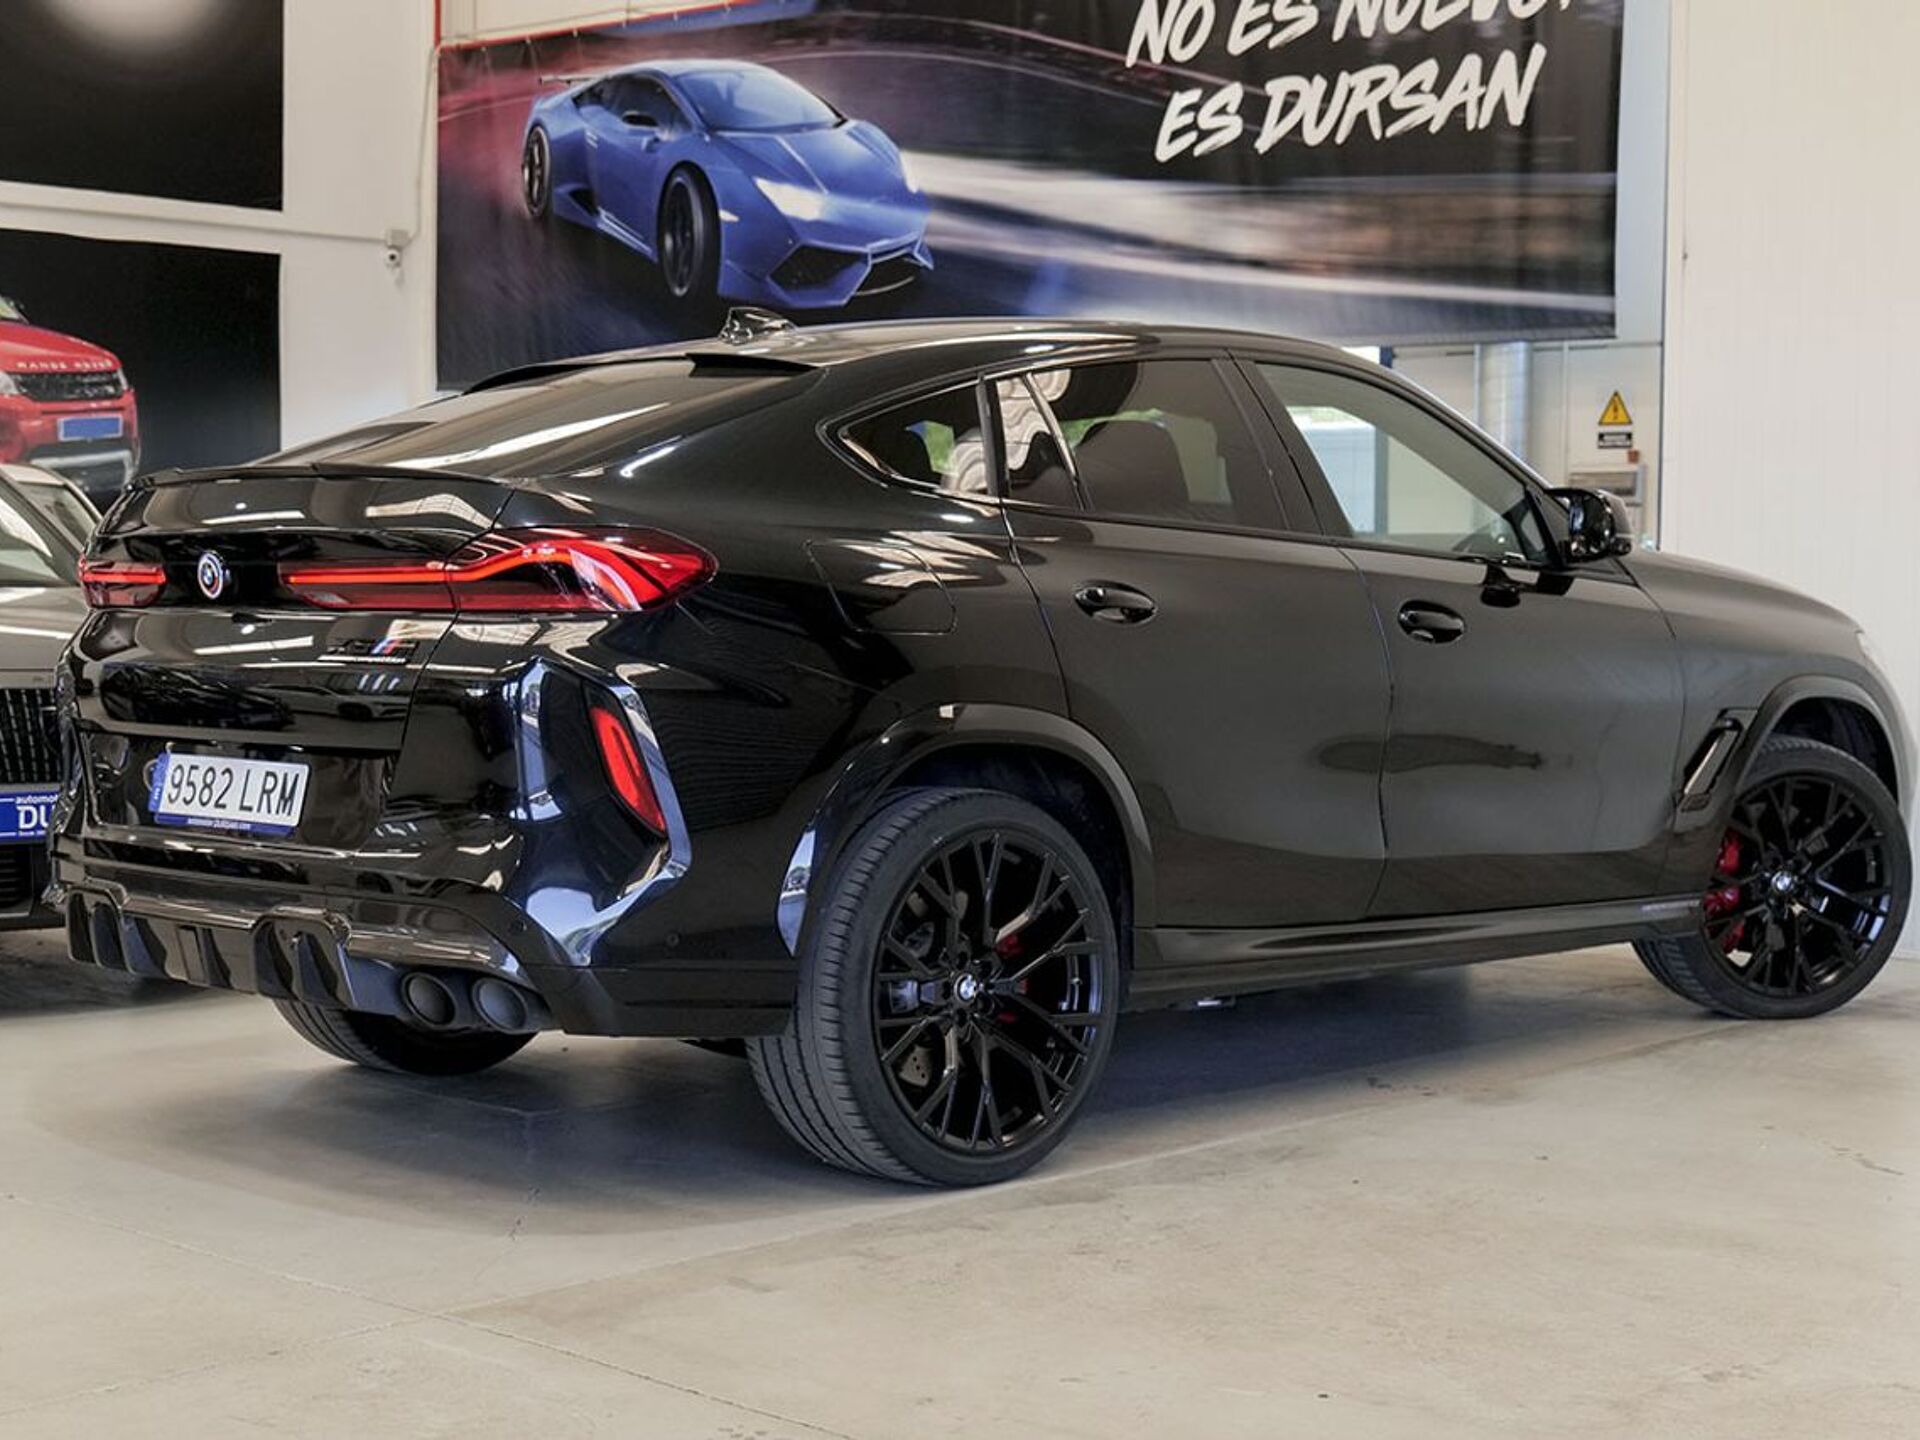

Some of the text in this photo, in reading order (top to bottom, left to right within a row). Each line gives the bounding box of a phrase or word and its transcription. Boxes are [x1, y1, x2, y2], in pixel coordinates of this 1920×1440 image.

[1125, 0, 1215, 68] NO
[1227, 0, 1319, 56] ES
[1155, 42, 1547, 162] ES DURSAN
[167, 763, 300, 817] 9582 LRM
